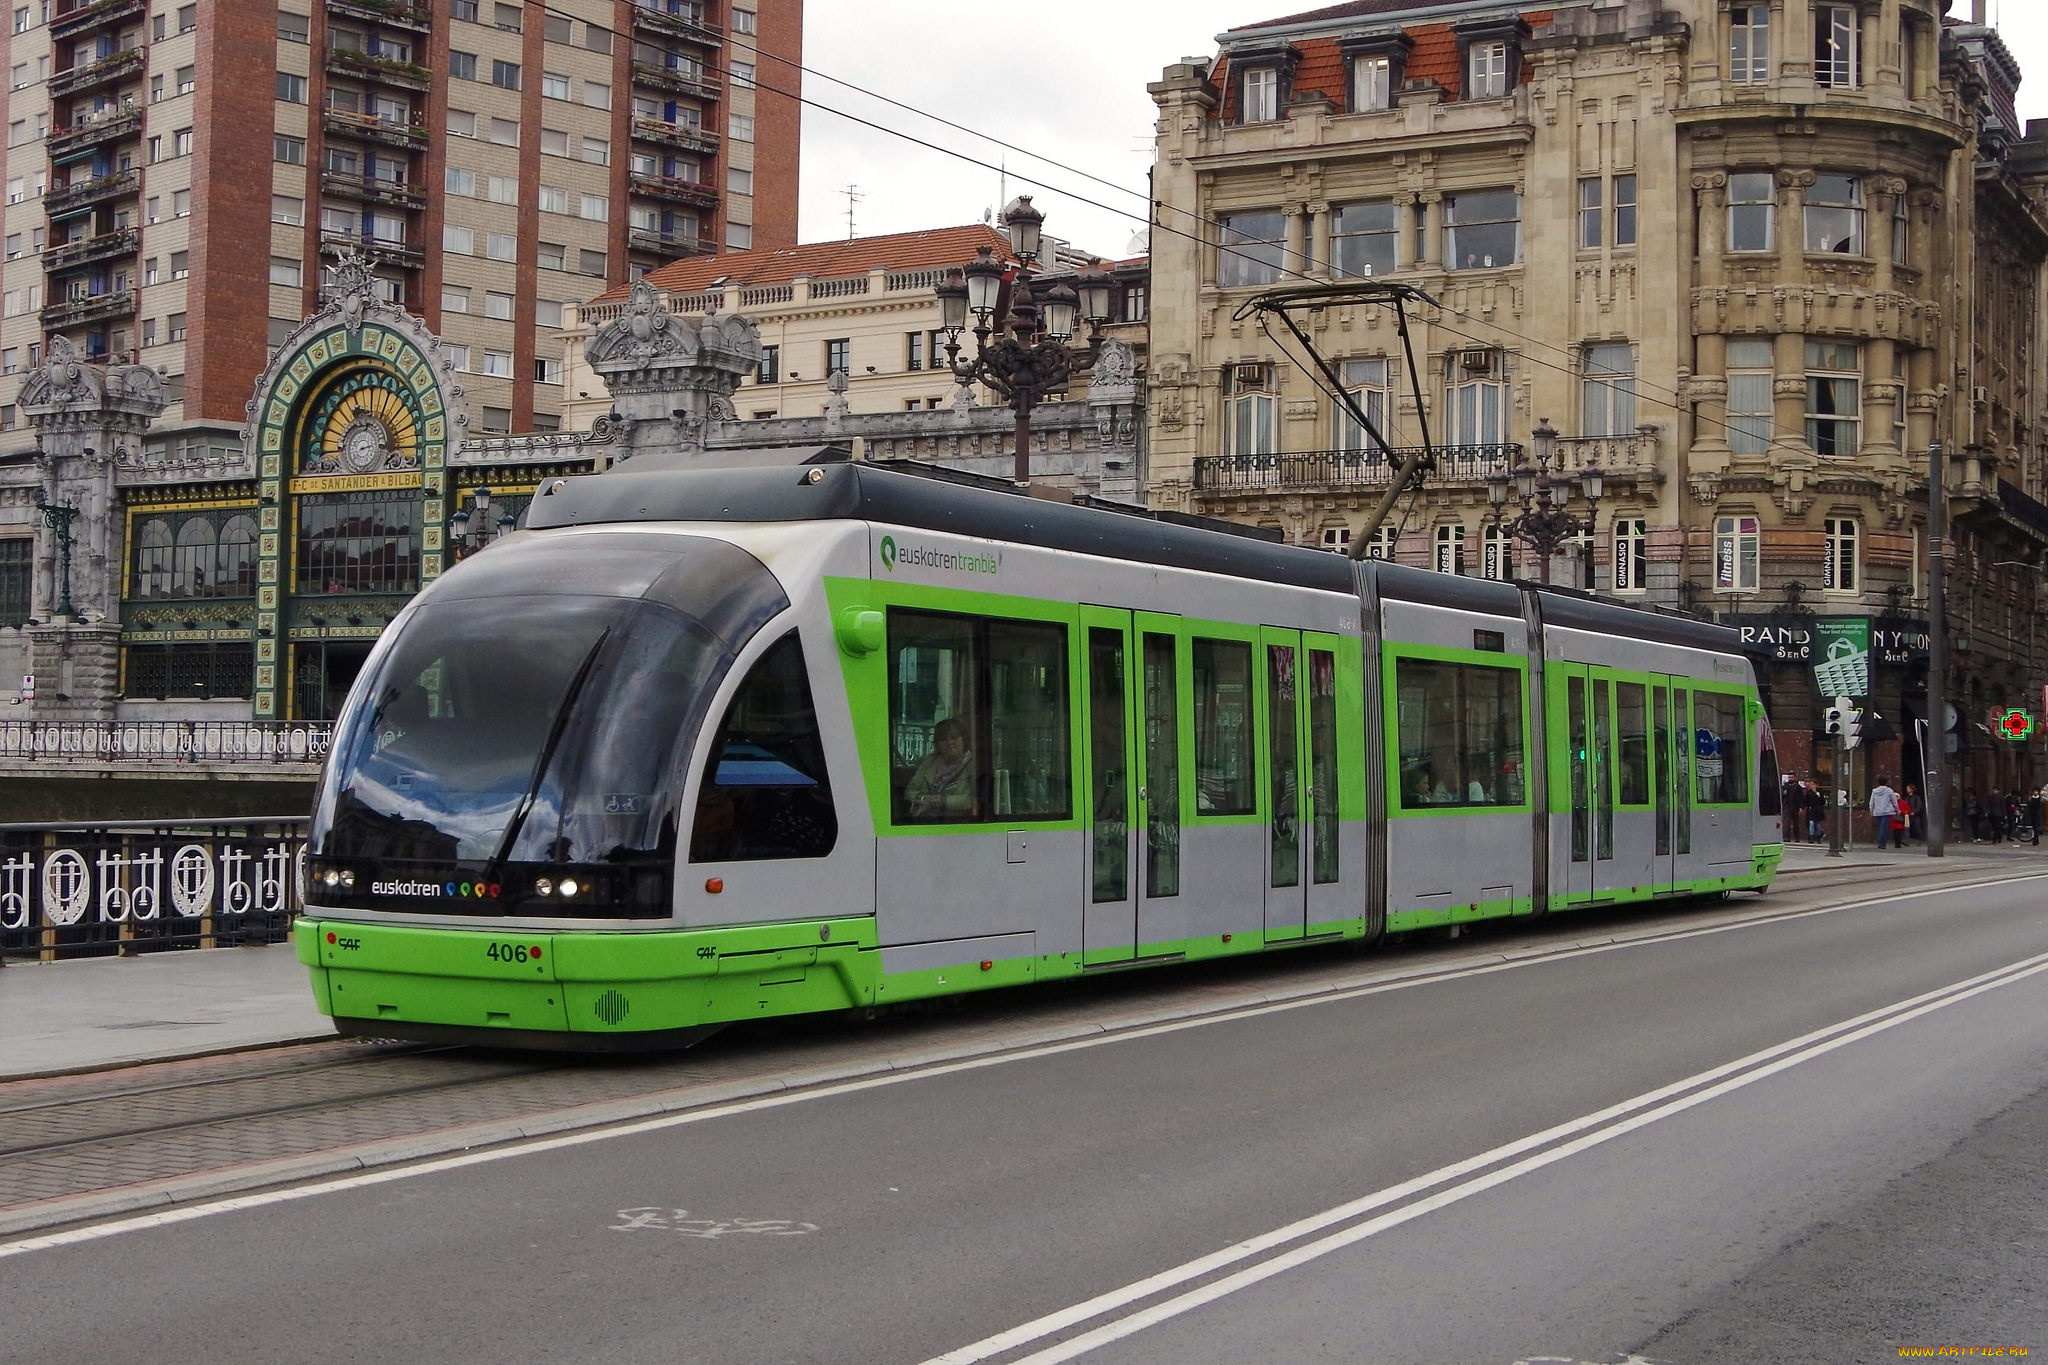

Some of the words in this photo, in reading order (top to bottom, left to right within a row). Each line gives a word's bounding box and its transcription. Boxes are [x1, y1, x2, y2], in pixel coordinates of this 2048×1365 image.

[321, 476, 378, 490] SANTANDER
[1618, 542, 1627, 587] GIMNASIO
[1721, 541, 1732, 582] fitness
[372, 879, 441, 897] euskotren
[338, 937, 361, 951] CAF
[486, 942, 528, 963] 406
[696, 946, 717, 960] CAF
